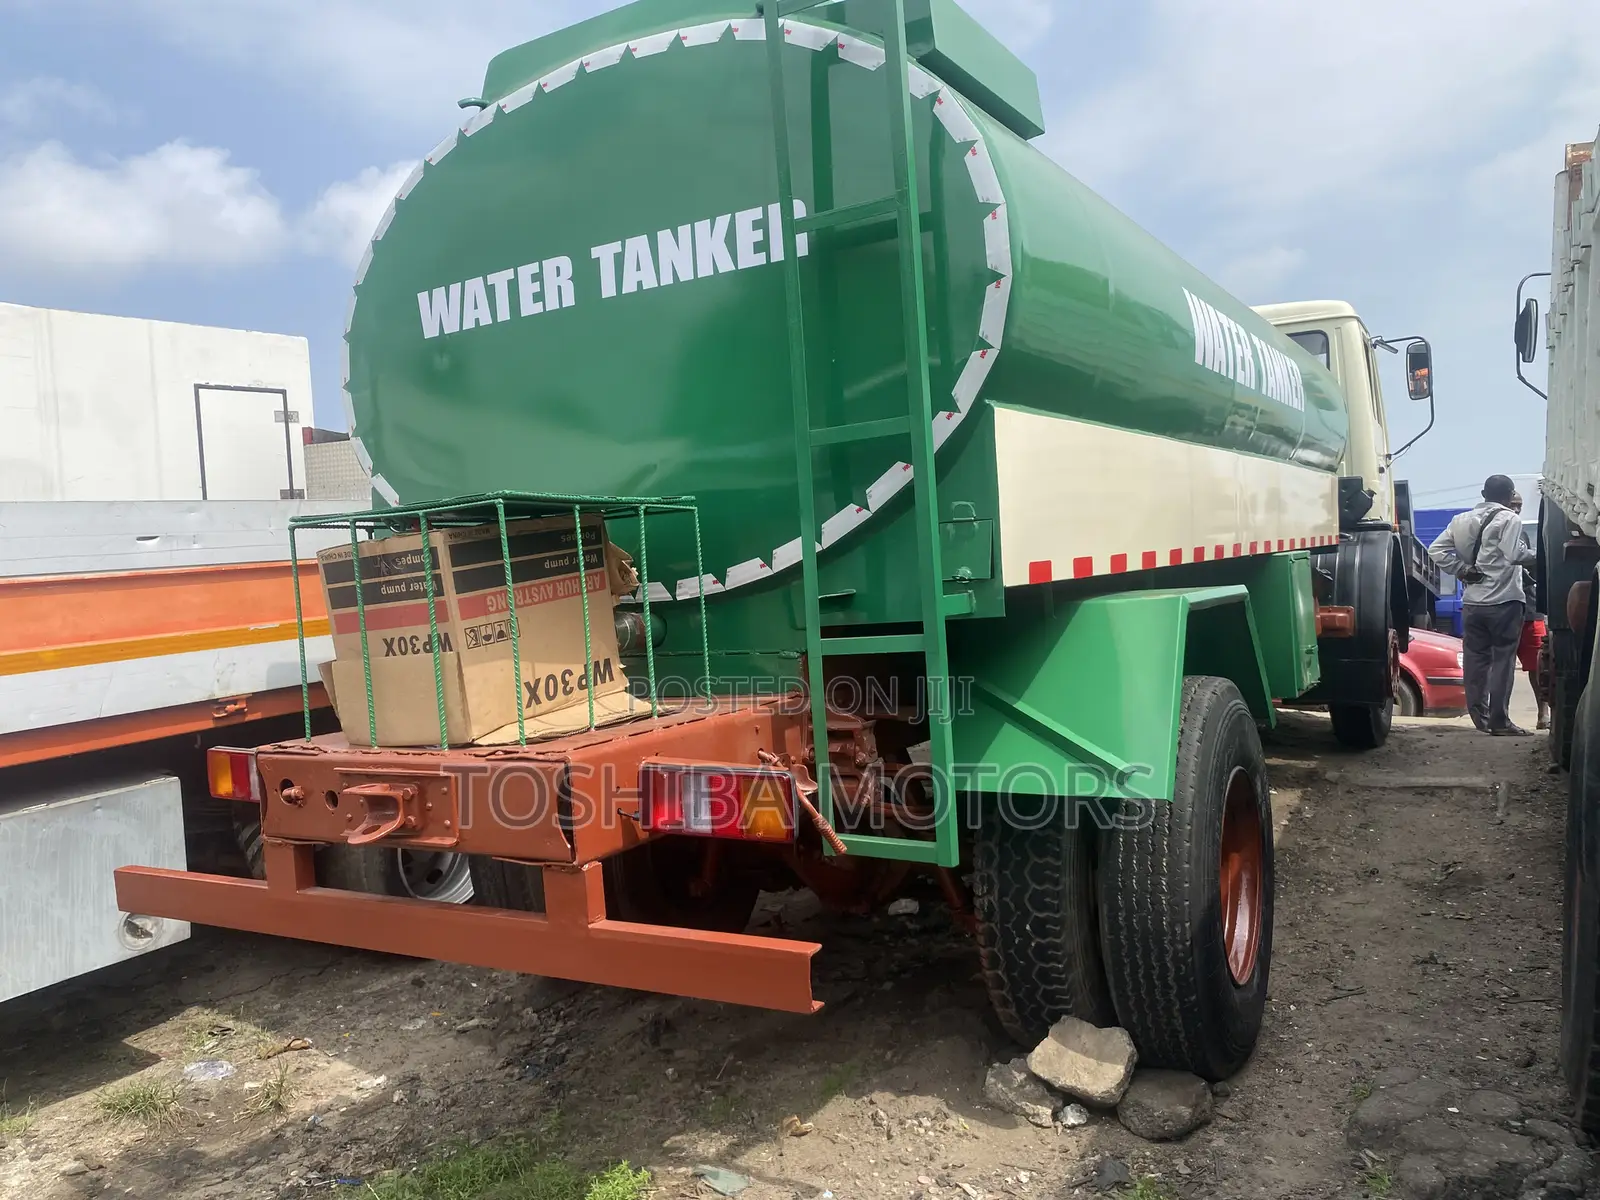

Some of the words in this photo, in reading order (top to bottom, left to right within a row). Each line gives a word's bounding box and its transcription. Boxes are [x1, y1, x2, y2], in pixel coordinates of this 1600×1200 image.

[417, 255, 576, 340] WATER
[1181, 286, 1256, 391] WATER
[1249, 332, 1305, 413] TANKER
[395, 553, 432, 566] ompes
[544, 556, 569, 569] pump
[380, 582, 407, 595] pump
[557, 573, 601, 597] ARHUR
[486, 584, 554, 612] AVSTRNG
[382, 632, 454, 657] WP30X
[523, 657, 615, 709] WP30X
